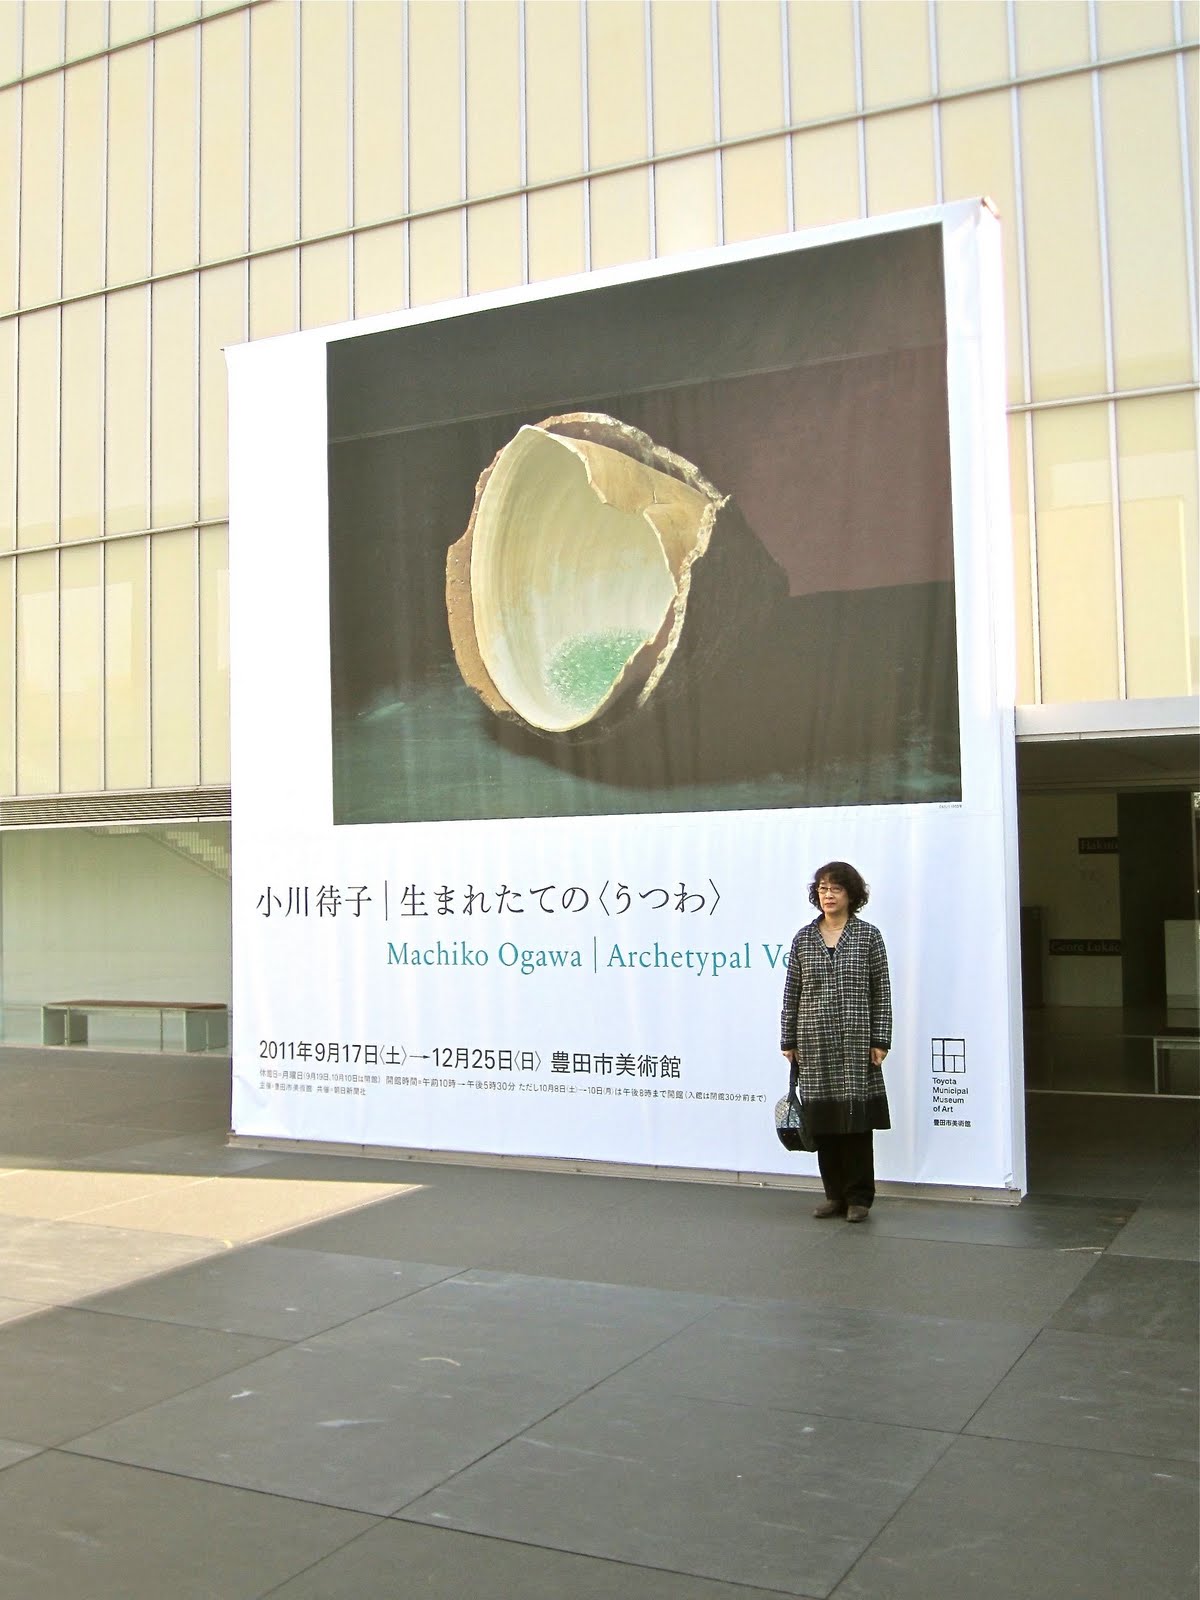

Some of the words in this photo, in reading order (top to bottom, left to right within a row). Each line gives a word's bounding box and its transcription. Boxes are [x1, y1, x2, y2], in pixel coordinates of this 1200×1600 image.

[256, 883, 373, 918] 小川待子
[387, 941, 489, 967] Machiko
[498, 941, 583, 975] Ogawa
[606, 941, 752, 977] Archetypal
[761, 943, 791, 969] Ve
[550, 1050, 681, 1080] 豊田市美術館
[932, 1077, 957, 1085] Toyota
[932, 1087, 969, 1096] Municipal
[932, 1096, 965, 1104] Museum
[932, 1105, 940, 1113] of
[941, 1105, 954, 1113] Art
